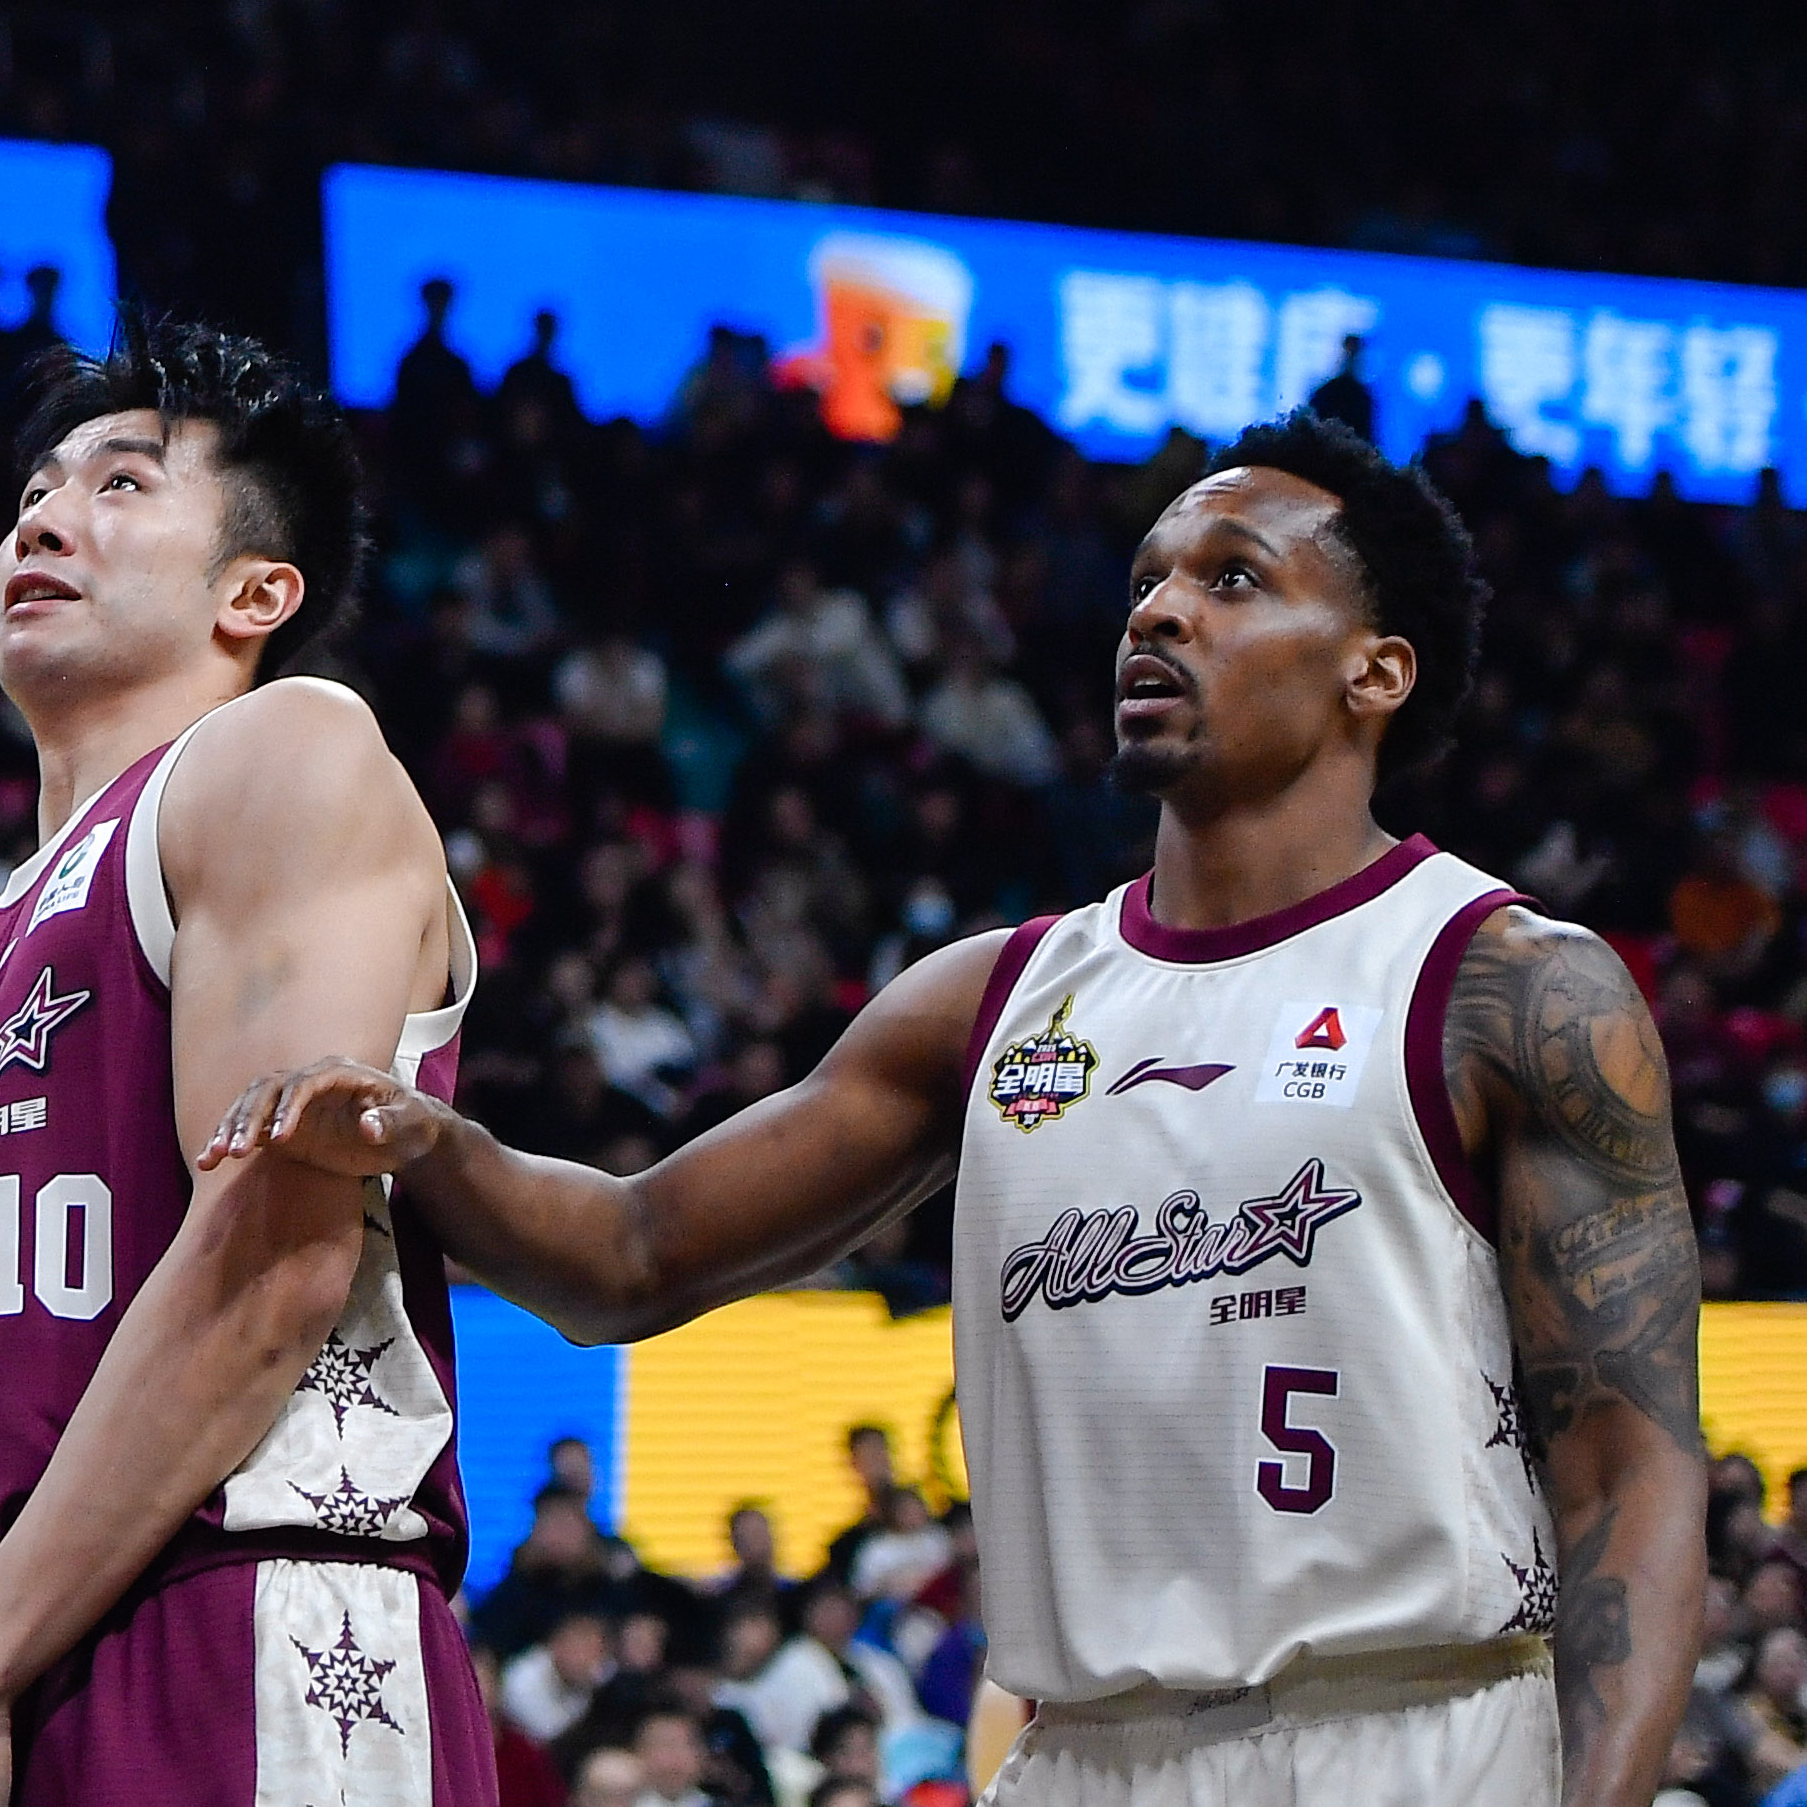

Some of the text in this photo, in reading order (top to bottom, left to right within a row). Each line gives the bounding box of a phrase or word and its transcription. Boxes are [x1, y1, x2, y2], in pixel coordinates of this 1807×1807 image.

[993, 1062, 1086, 1097] 全明星
[1274, 1061, 1348, 1080] 广发银行
[1283, 1081, 1326, 1099] CGB
[1209, 1285, 1307, 1327] 全明星
[1255, 1364, 1341, 1517] 5
